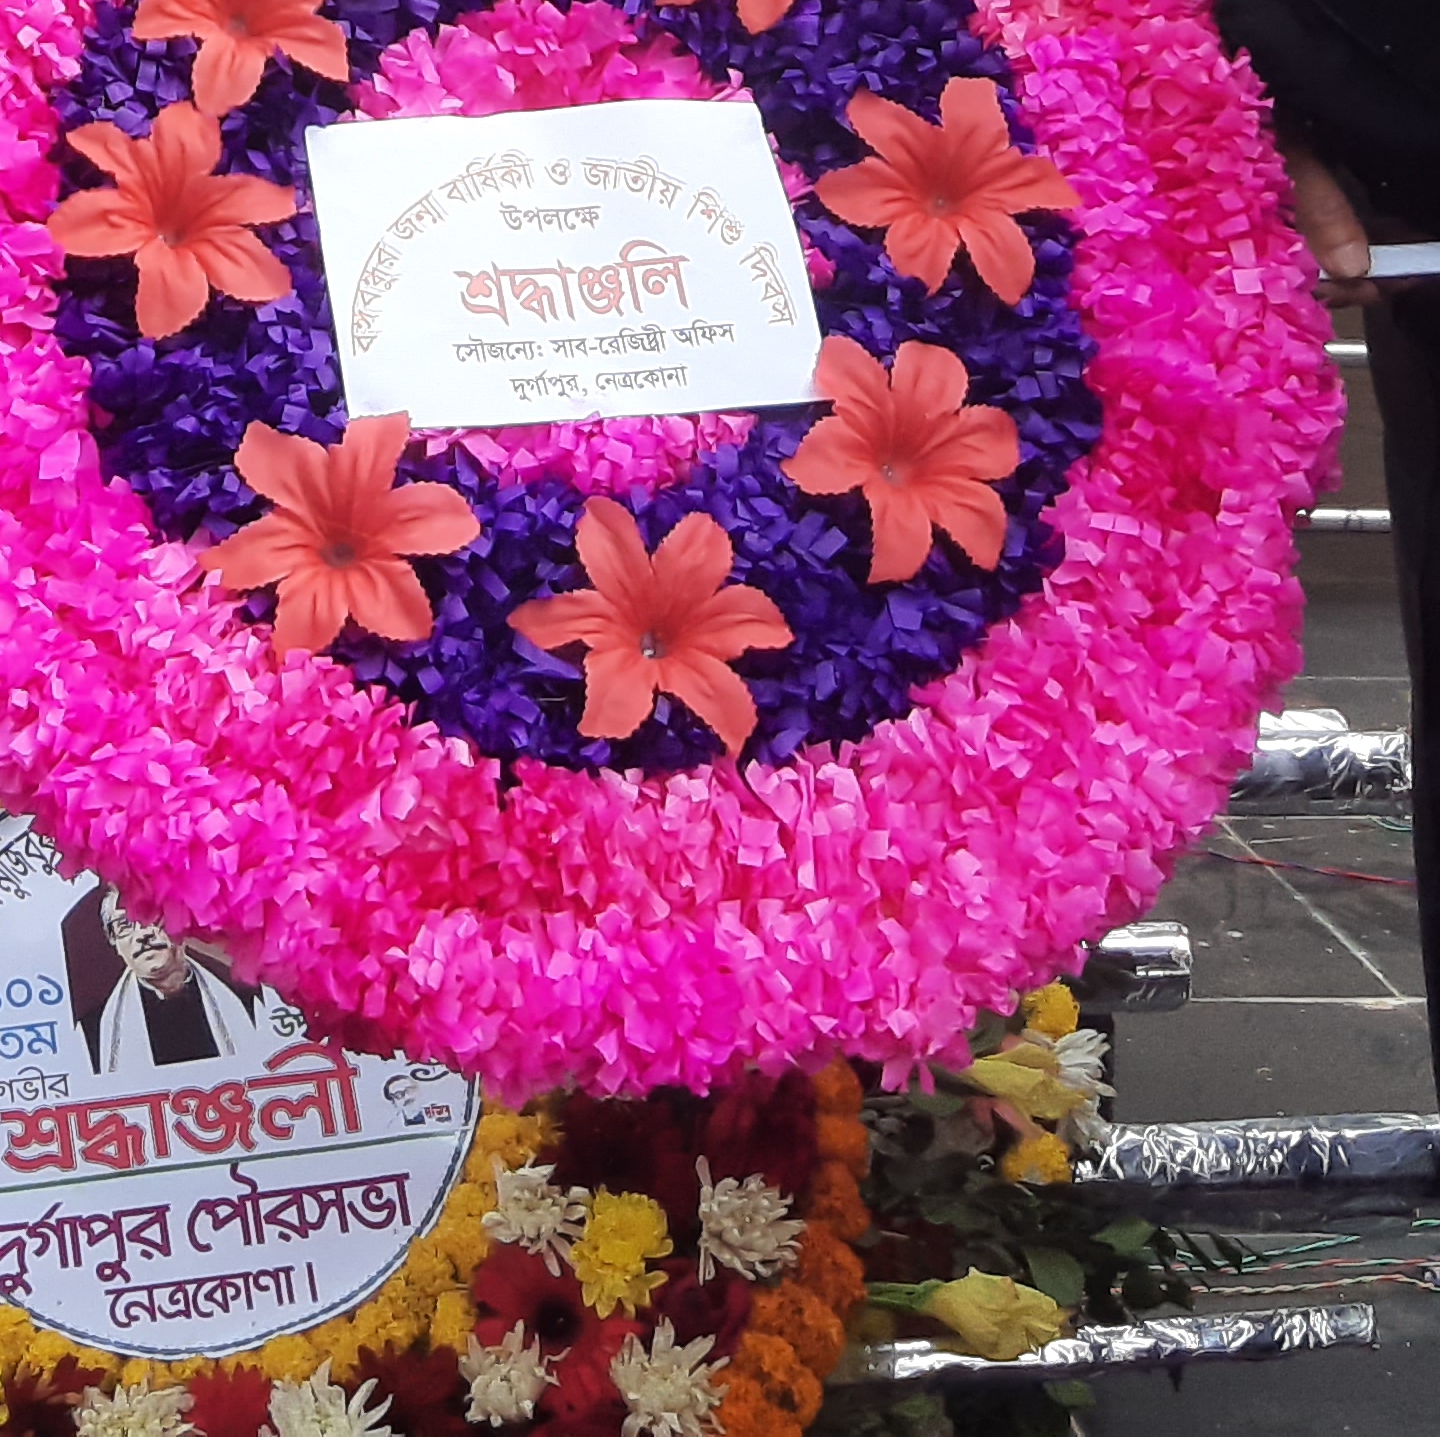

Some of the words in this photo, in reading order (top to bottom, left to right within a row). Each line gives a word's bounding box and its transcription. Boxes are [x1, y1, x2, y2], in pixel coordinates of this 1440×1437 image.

[438, 150, 533, 203] বার্ষিকী
[545, 158, 570, 185] ও
[580, 156, 686, 210] জাতীয়
[687, 187, 745, 245] শিশু
[739, 242, 797, 326] দিবস
[499, 201, 601, 233] উপলক্ষে
[453, 240, 690, 326] শ্রদ্ধাঞ্জলি
[452, 334, 543, 363] সৌজন্যে:
[670, 319, 735, 348] অফিস
[509, 369, 588, 402] দুর্গাপুর,
[595, 364, 688, 392] নেত্রকোনা
[0, 1039, 362, 1178] শ্রদ্ধাঞ্জলী
[186, 1161, 413, 1249] পৌরসভা
